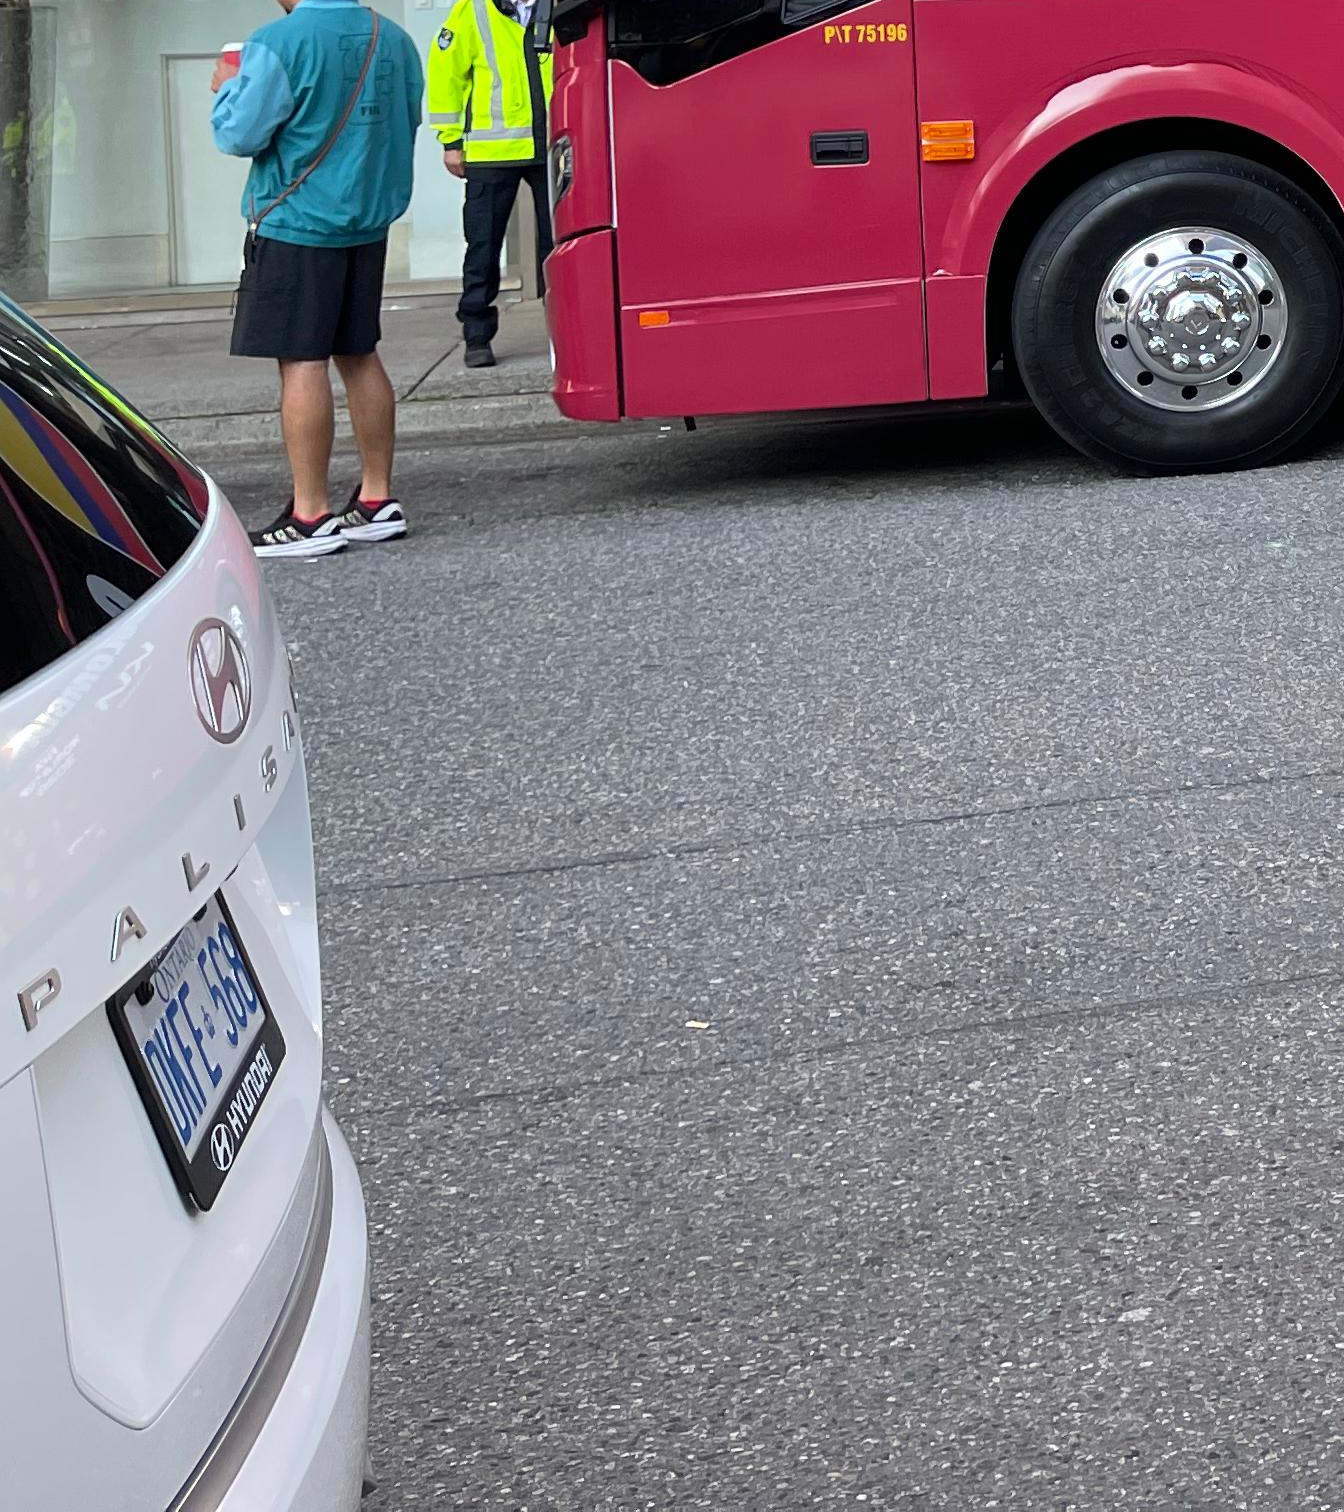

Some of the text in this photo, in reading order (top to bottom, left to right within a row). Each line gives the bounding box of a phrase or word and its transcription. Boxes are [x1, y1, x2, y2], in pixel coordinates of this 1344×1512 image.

[856, 23, 907, 43] 75196
[151, 924, 196, 1003] ONTARIO
[197, 922, 257, 1048] 568
[226, 1044, 274, 1140] HYUNDAI
